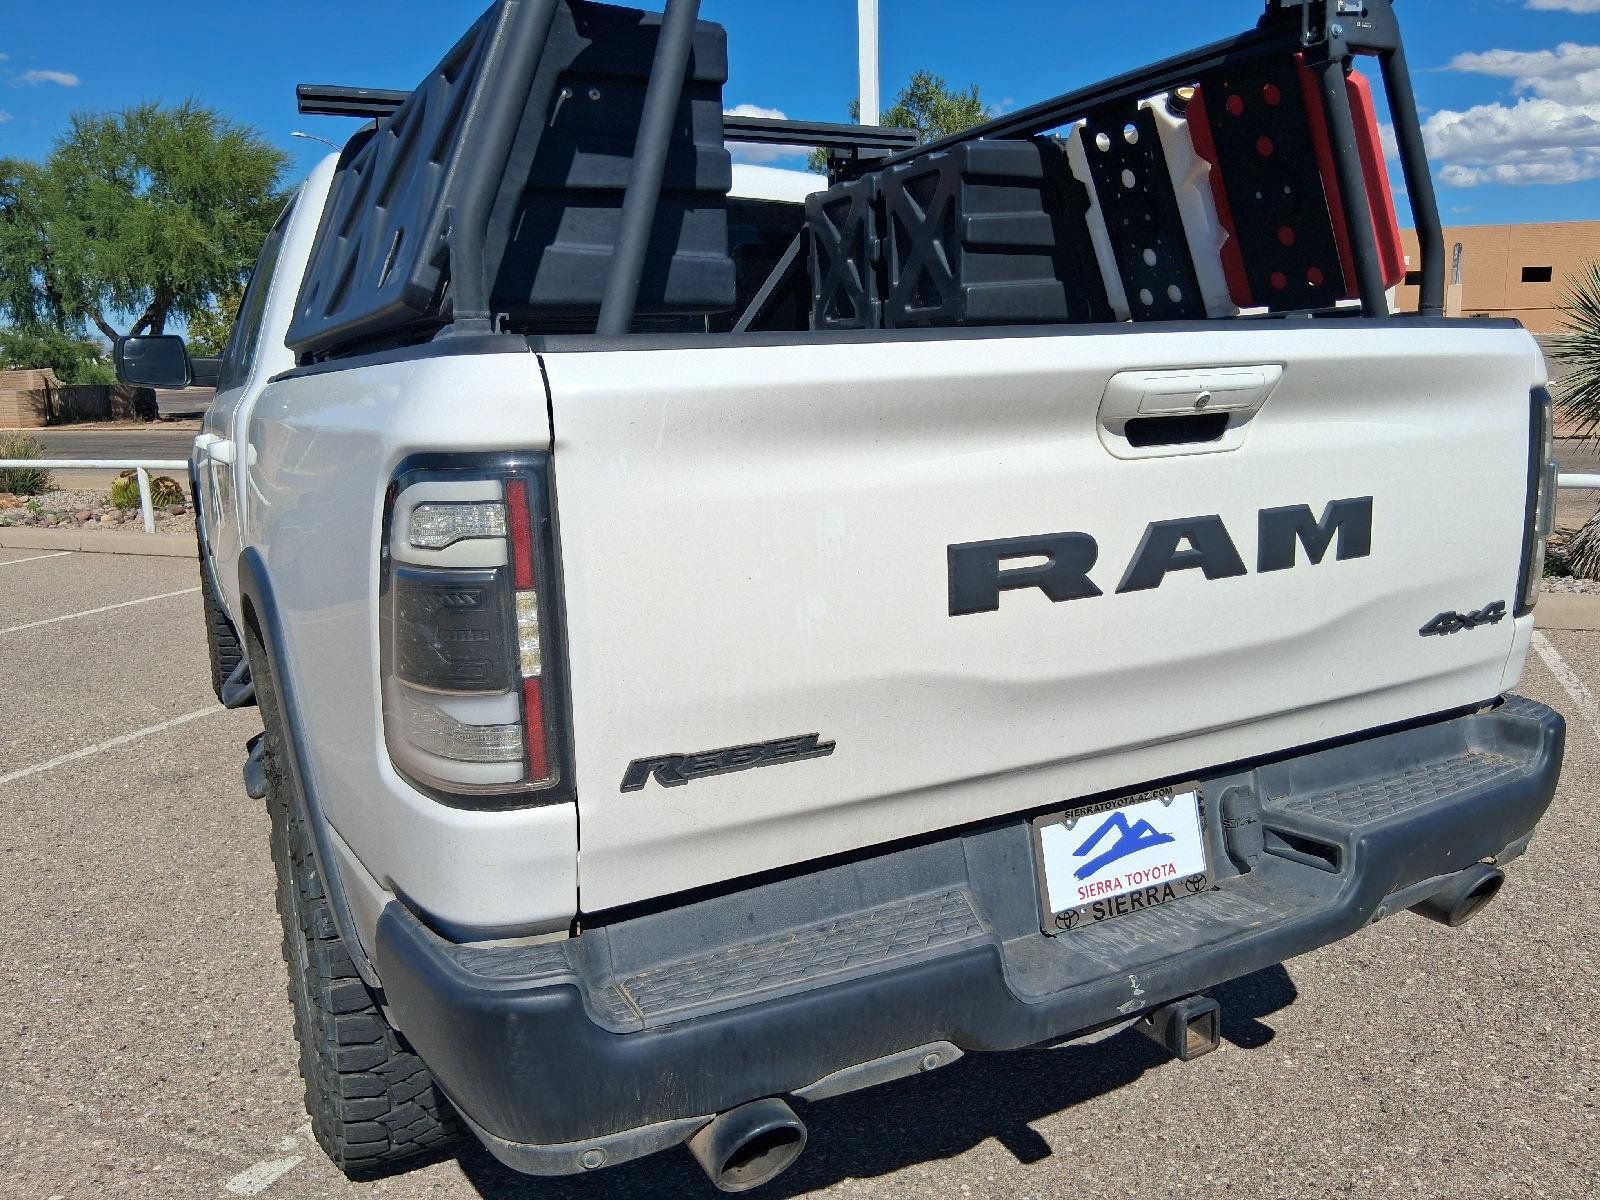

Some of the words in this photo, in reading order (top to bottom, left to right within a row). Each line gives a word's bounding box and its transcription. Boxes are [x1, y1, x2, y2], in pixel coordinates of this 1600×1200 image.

[948, 496, 1374, 617] RAM
[620, 732, 837, 793] REBEL
[1077, 877, 1123, 900] SIERRA
[1124, 862, 1177, 887] TOYOTA
[1092, 881, 1176, 921] SIERRA
